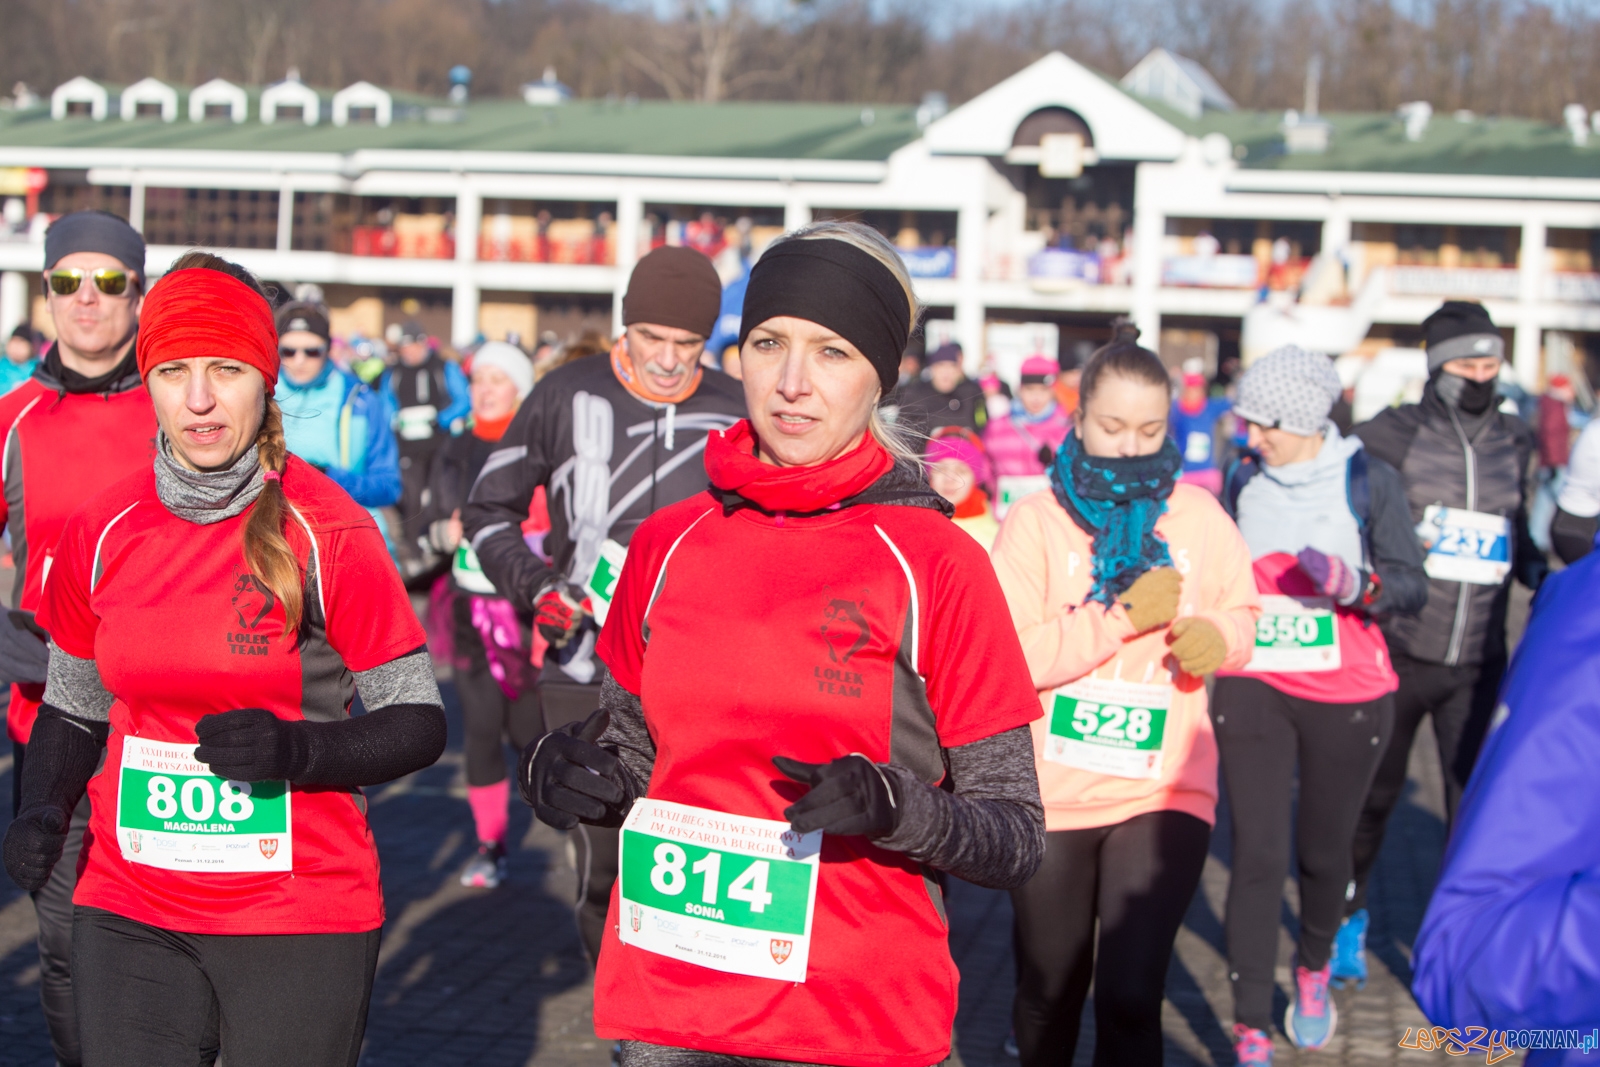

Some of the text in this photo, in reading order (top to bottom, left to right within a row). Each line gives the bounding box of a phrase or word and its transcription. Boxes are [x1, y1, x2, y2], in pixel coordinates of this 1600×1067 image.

[1439, 526, 1497, 557] 237
[227, 632, 270, 644] LOLEK
[1257, 616, 1319, 644] 550
[229, 644, 268, 655] TEAM
[815, 666, 863, 685] LOLEK
[817, 680, 860, 698] TEAM
[1071, 700, 1152, 743] 528
[140, 746, 162, 757] XXXII
[164, 750, 188, 760] BIEG
[147, 775, 254, 821] 808
[163, 821, 236, 833] MAGDALENA
[680, 813, 705, 828] BIEG
[707, 818, 805, 844] SYLWESTROWY
[668, 827, 728, 848] RYSZARDA
[650, 842, 772, 913] 814
[685, 902, 725, 921] SONIA
